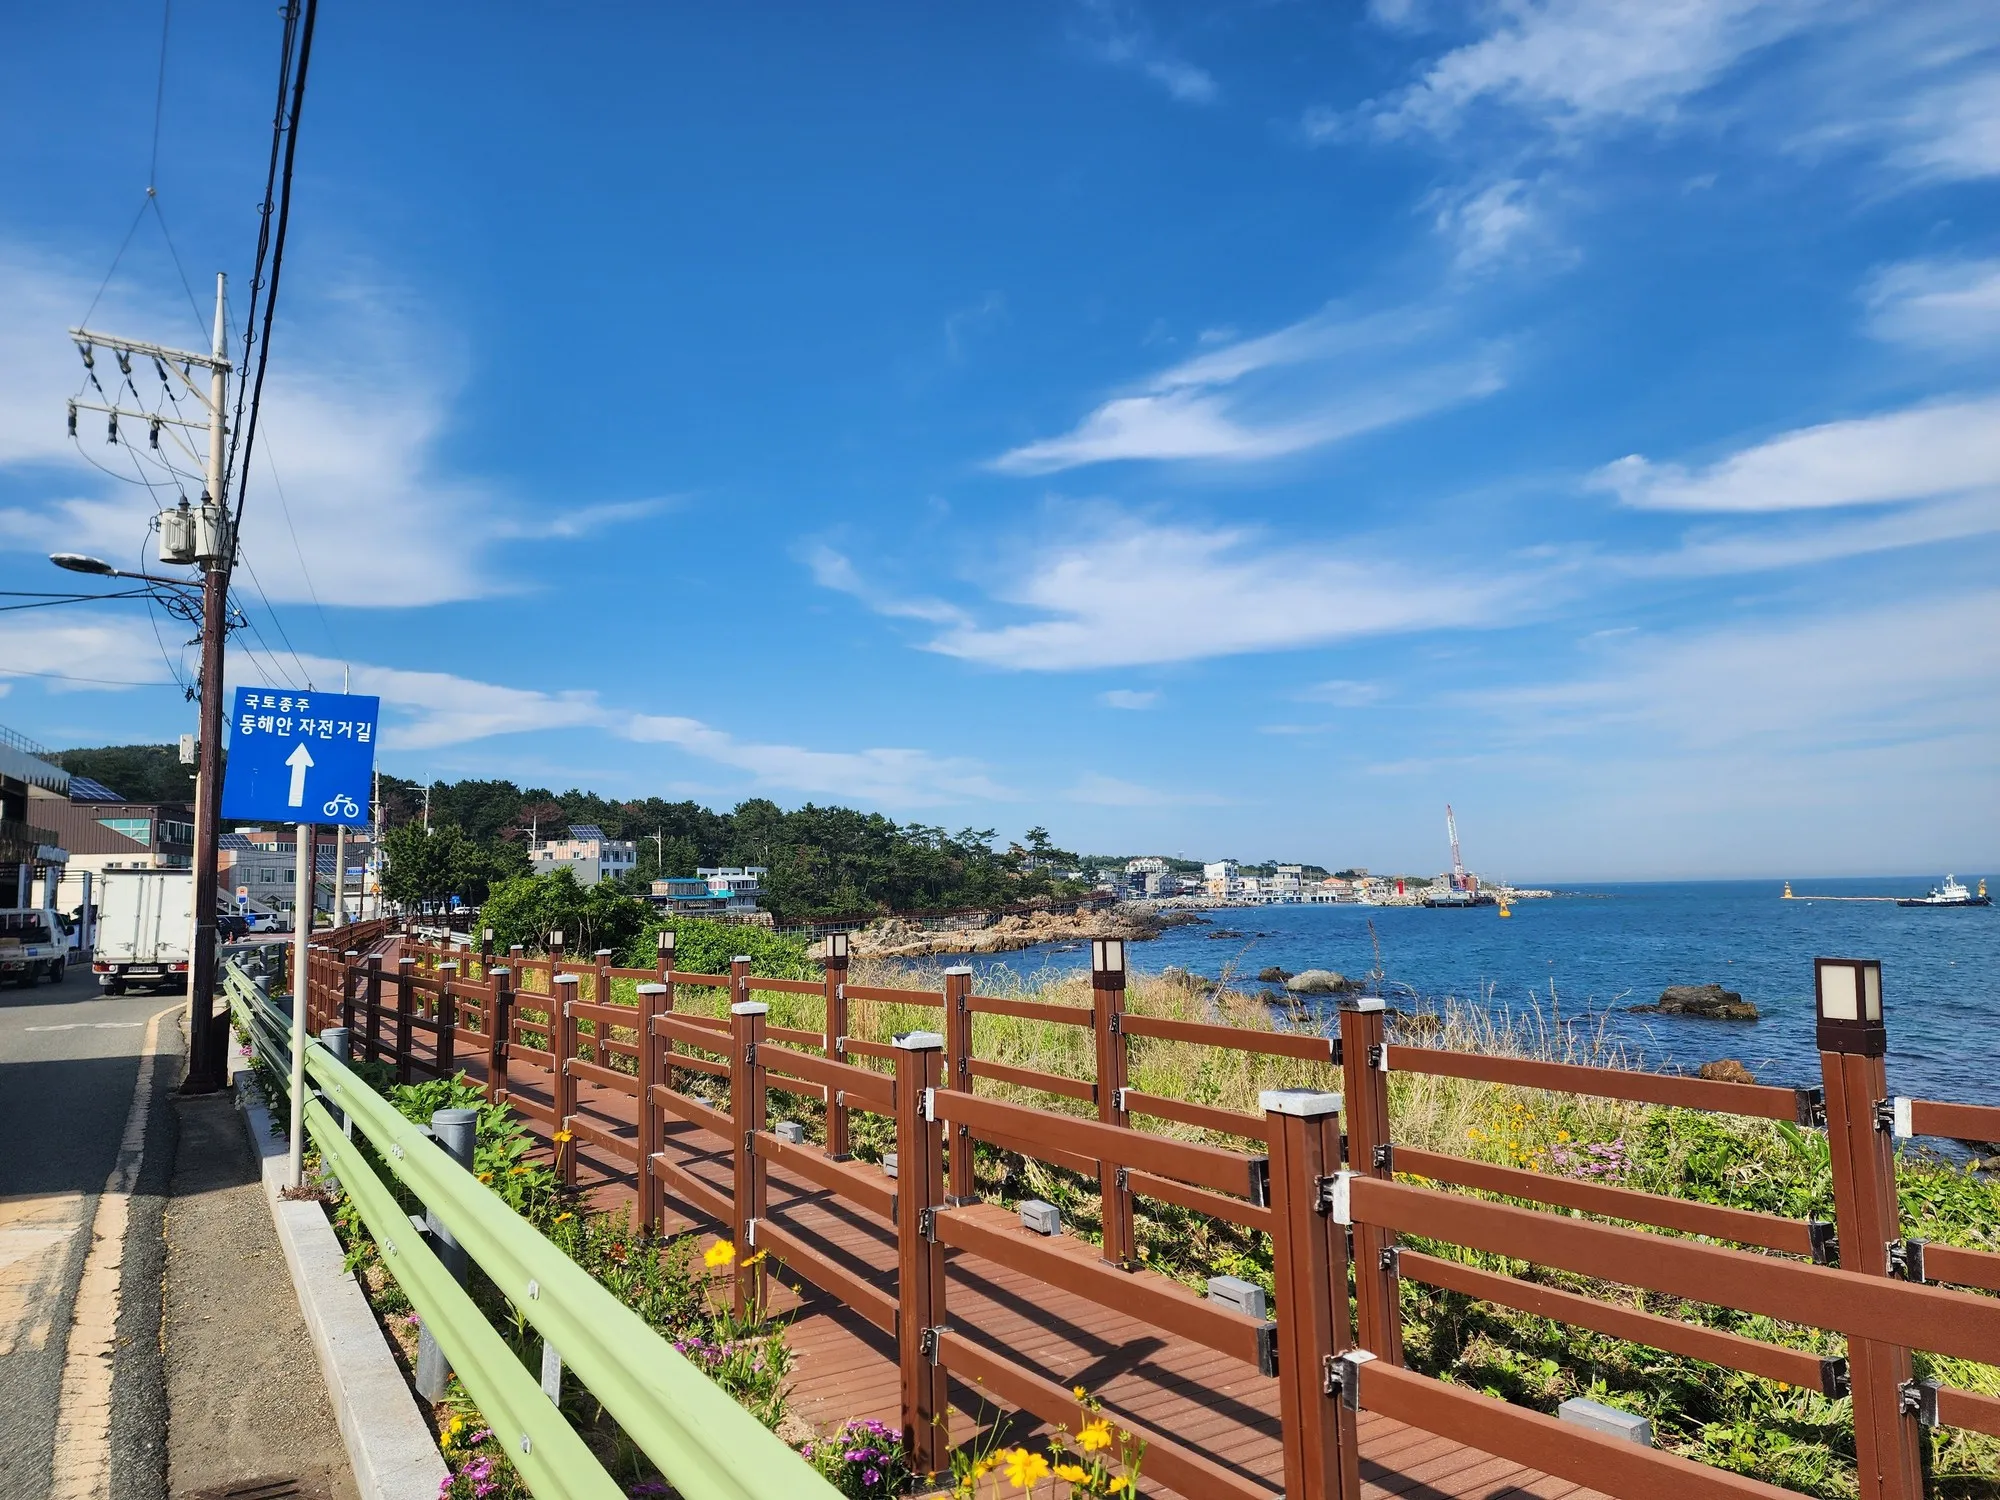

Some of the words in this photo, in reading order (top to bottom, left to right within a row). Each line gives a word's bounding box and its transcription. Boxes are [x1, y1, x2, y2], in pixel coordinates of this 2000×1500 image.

[244, 694, 310, 713] 국토종주
[239, 714, 293, 737] 동해안
[298, 718, 372, 743] 자전거길
